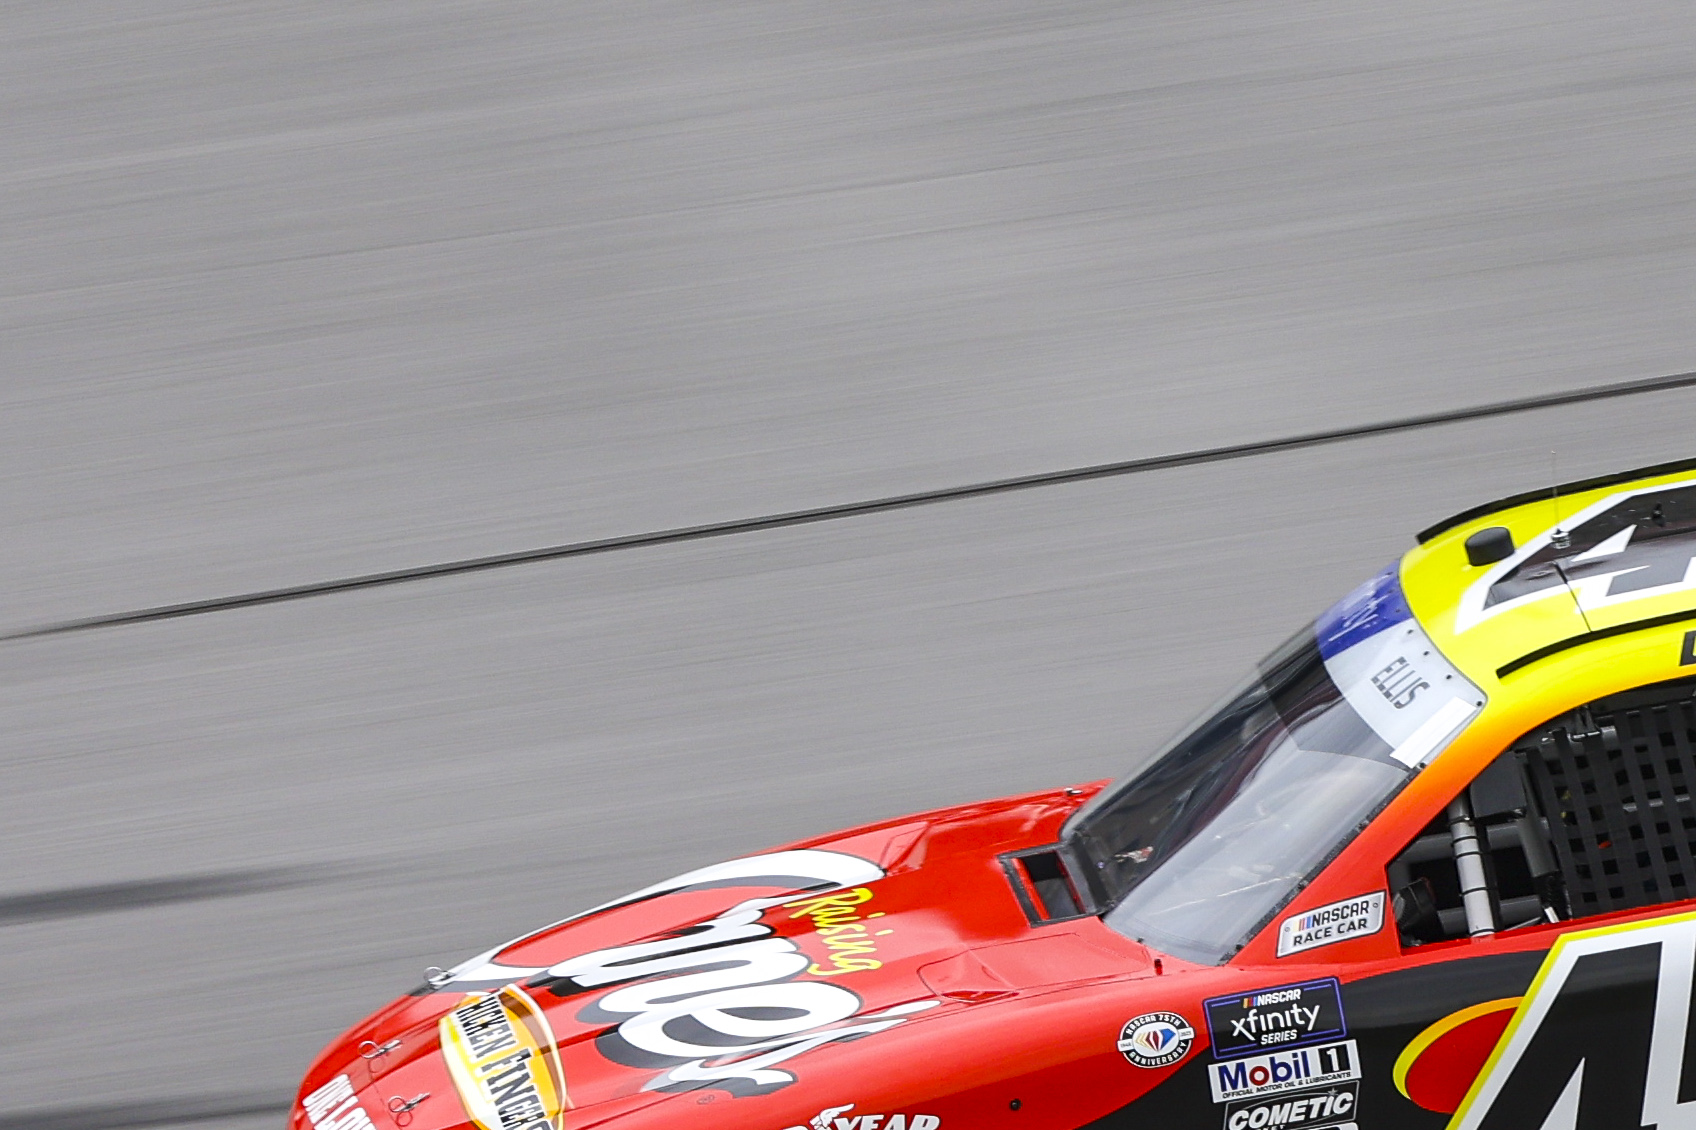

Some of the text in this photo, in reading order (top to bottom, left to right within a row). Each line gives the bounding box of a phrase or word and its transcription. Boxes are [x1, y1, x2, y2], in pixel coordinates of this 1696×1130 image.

[1369, 655, 1431, 710] ELLIS
[1311, 900, 1370, 928] NASCAR
[782, 887, 894, 976] Raising
[1293, 918, 1368, 947] RACE CAR
[1256, 988, 1303, 1007] NASCAR
[455, 988, 518, 1060] HICKEN
[1125, 1013, 1182, 1036] NASCAR 75TH
[1230, 1003, 1321, 1041] xfinity
[1260, 1029, 1299, 1046] SERIES
[1128, 1041, 1188, 1066] ANNIVERSARY
[1217, 1047, 1340, 1093] Mobil 1
[301, 1073, 355, 1125] ONE
[1222, 1088, 1254, 1099] OFFICIAL
[1256, 1083, 1284, 1094] MOTOR
[1284, 1080, 1296, 1089] OIL
[1305, 1071, 1353, 1085] LUBRICANTS
